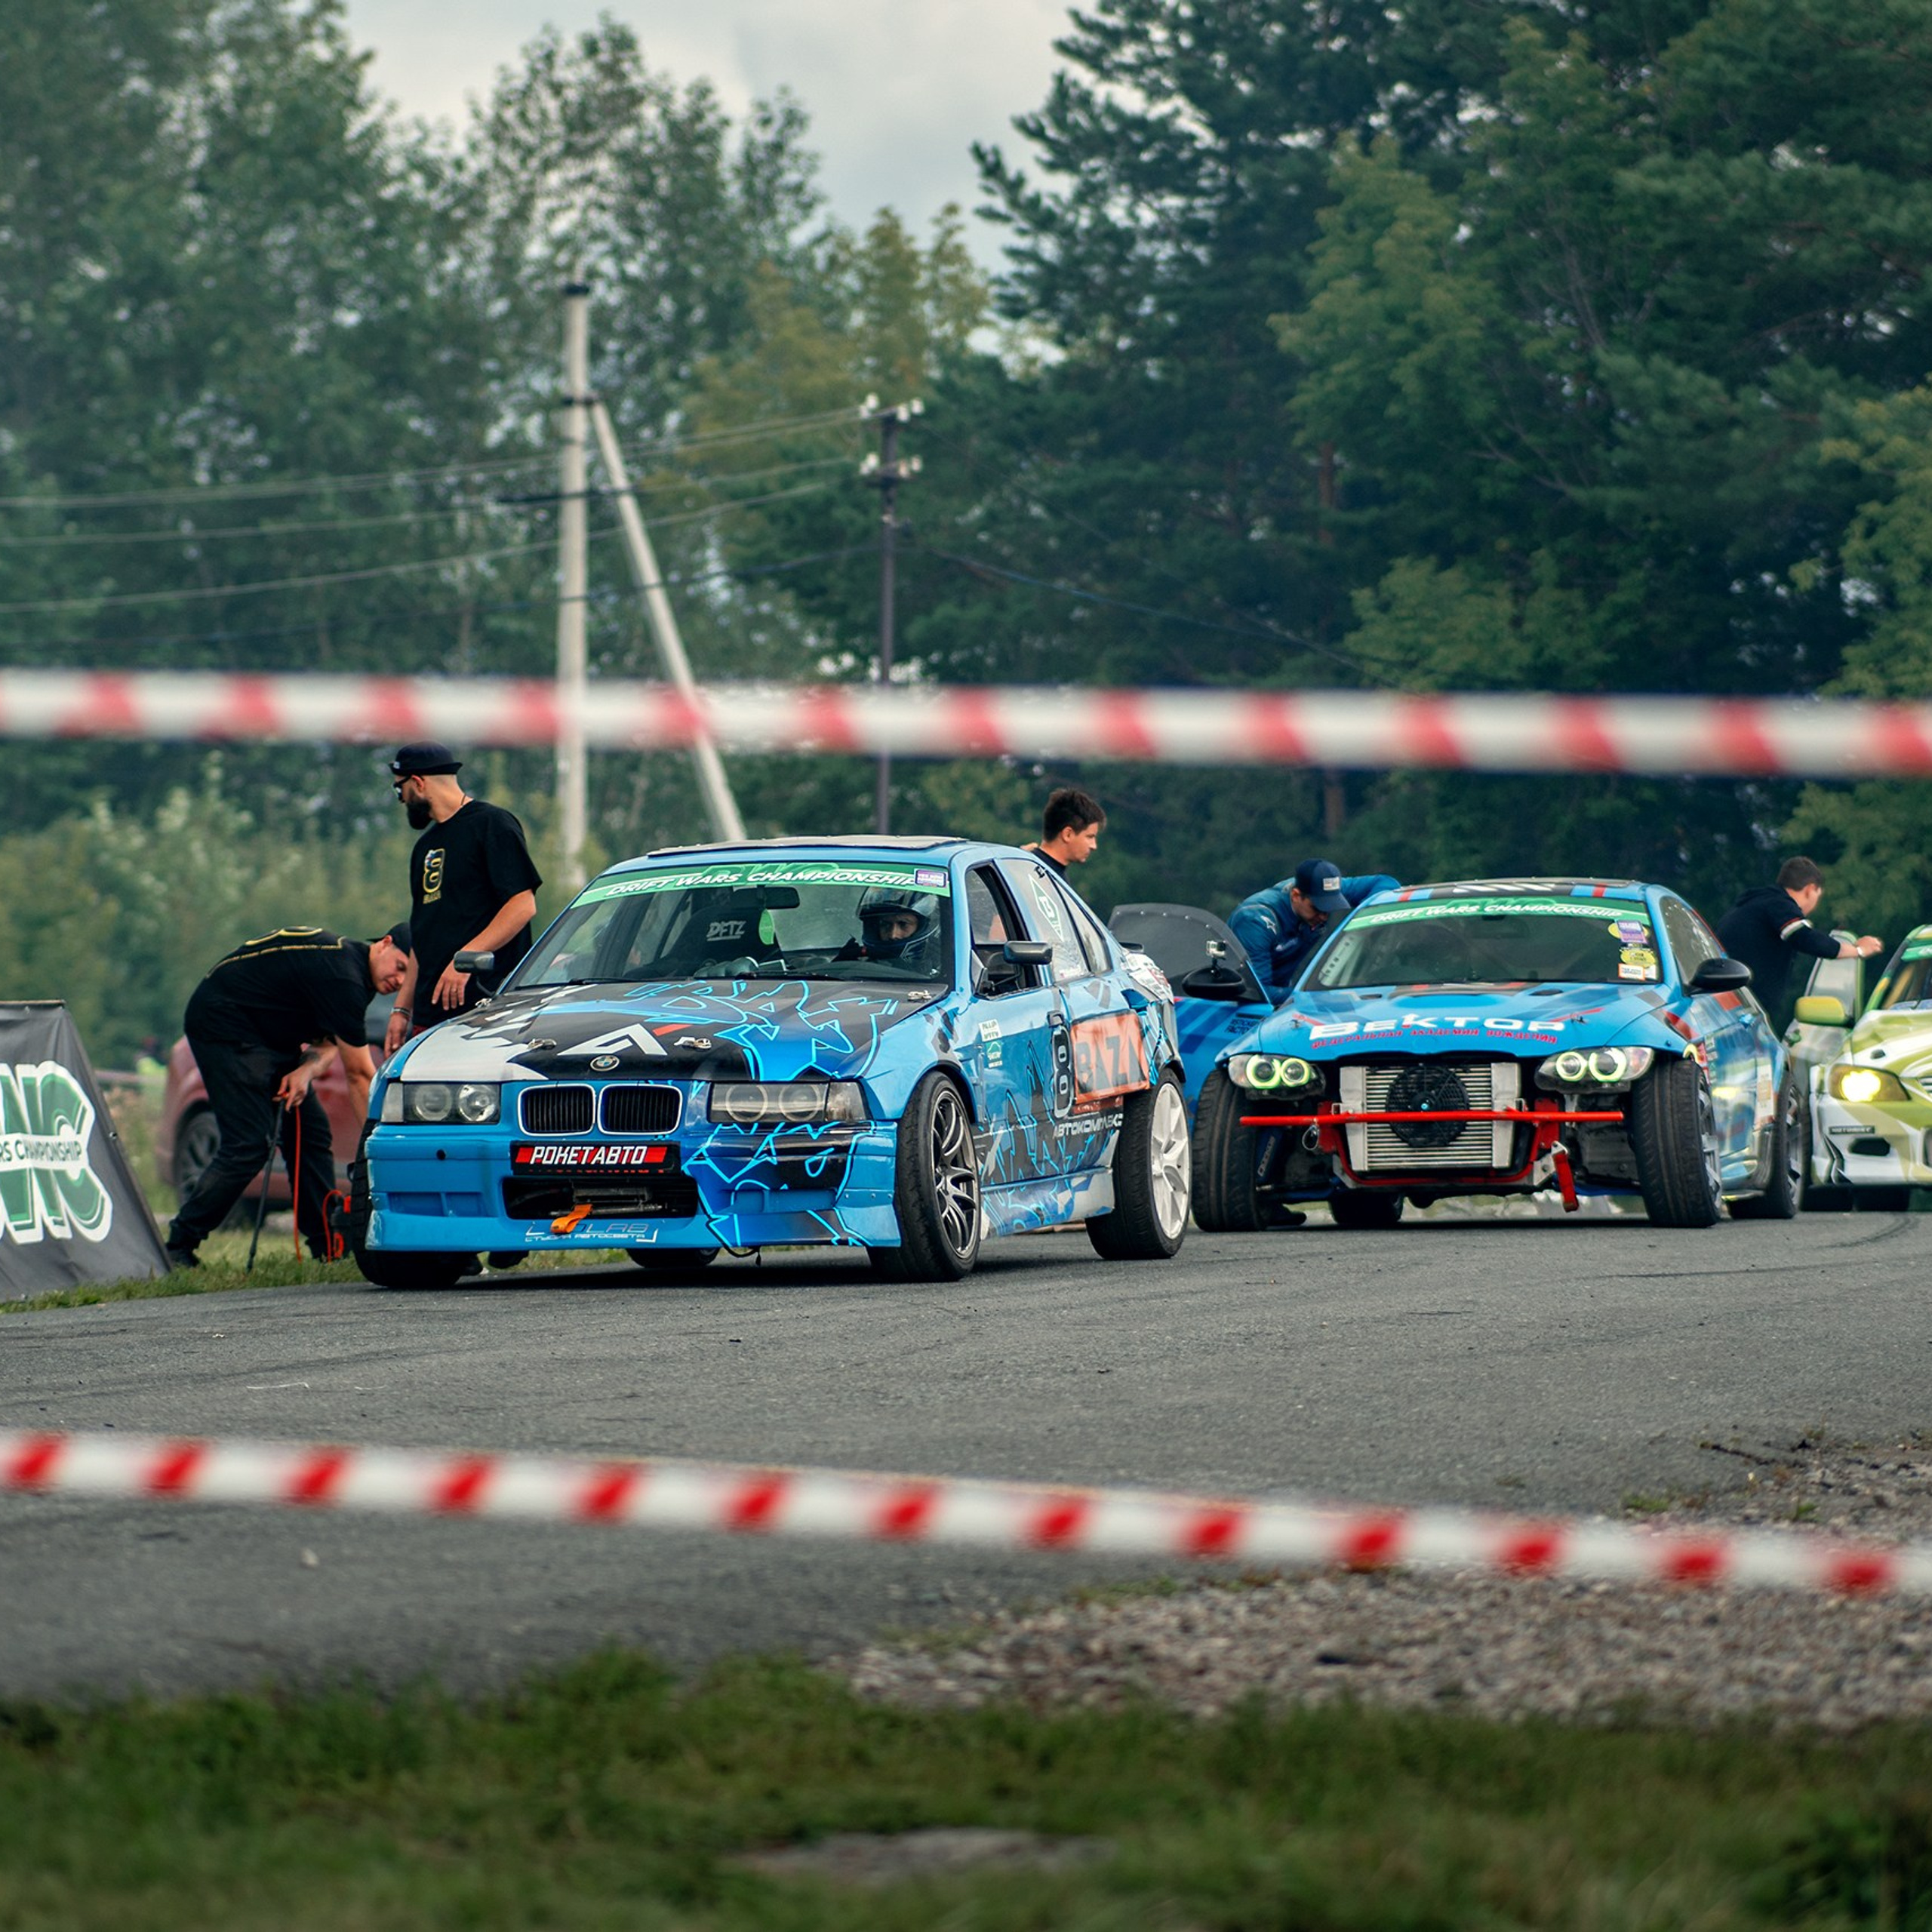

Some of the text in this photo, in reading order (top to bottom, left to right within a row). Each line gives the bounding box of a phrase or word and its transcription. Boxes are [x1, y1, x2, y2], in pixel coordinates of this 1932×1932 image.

[605, 878, 674, 897] DRIFT
[676, 872, 743, 887] WARS
[746, 872, 915, 886] CHAMPIONSHIP
[1370, 904, 1623, 924] DRIFT WARS CHAMPIONSHIP
[1410, 1028, 1479, 1036] АКАДЕМИЯ
